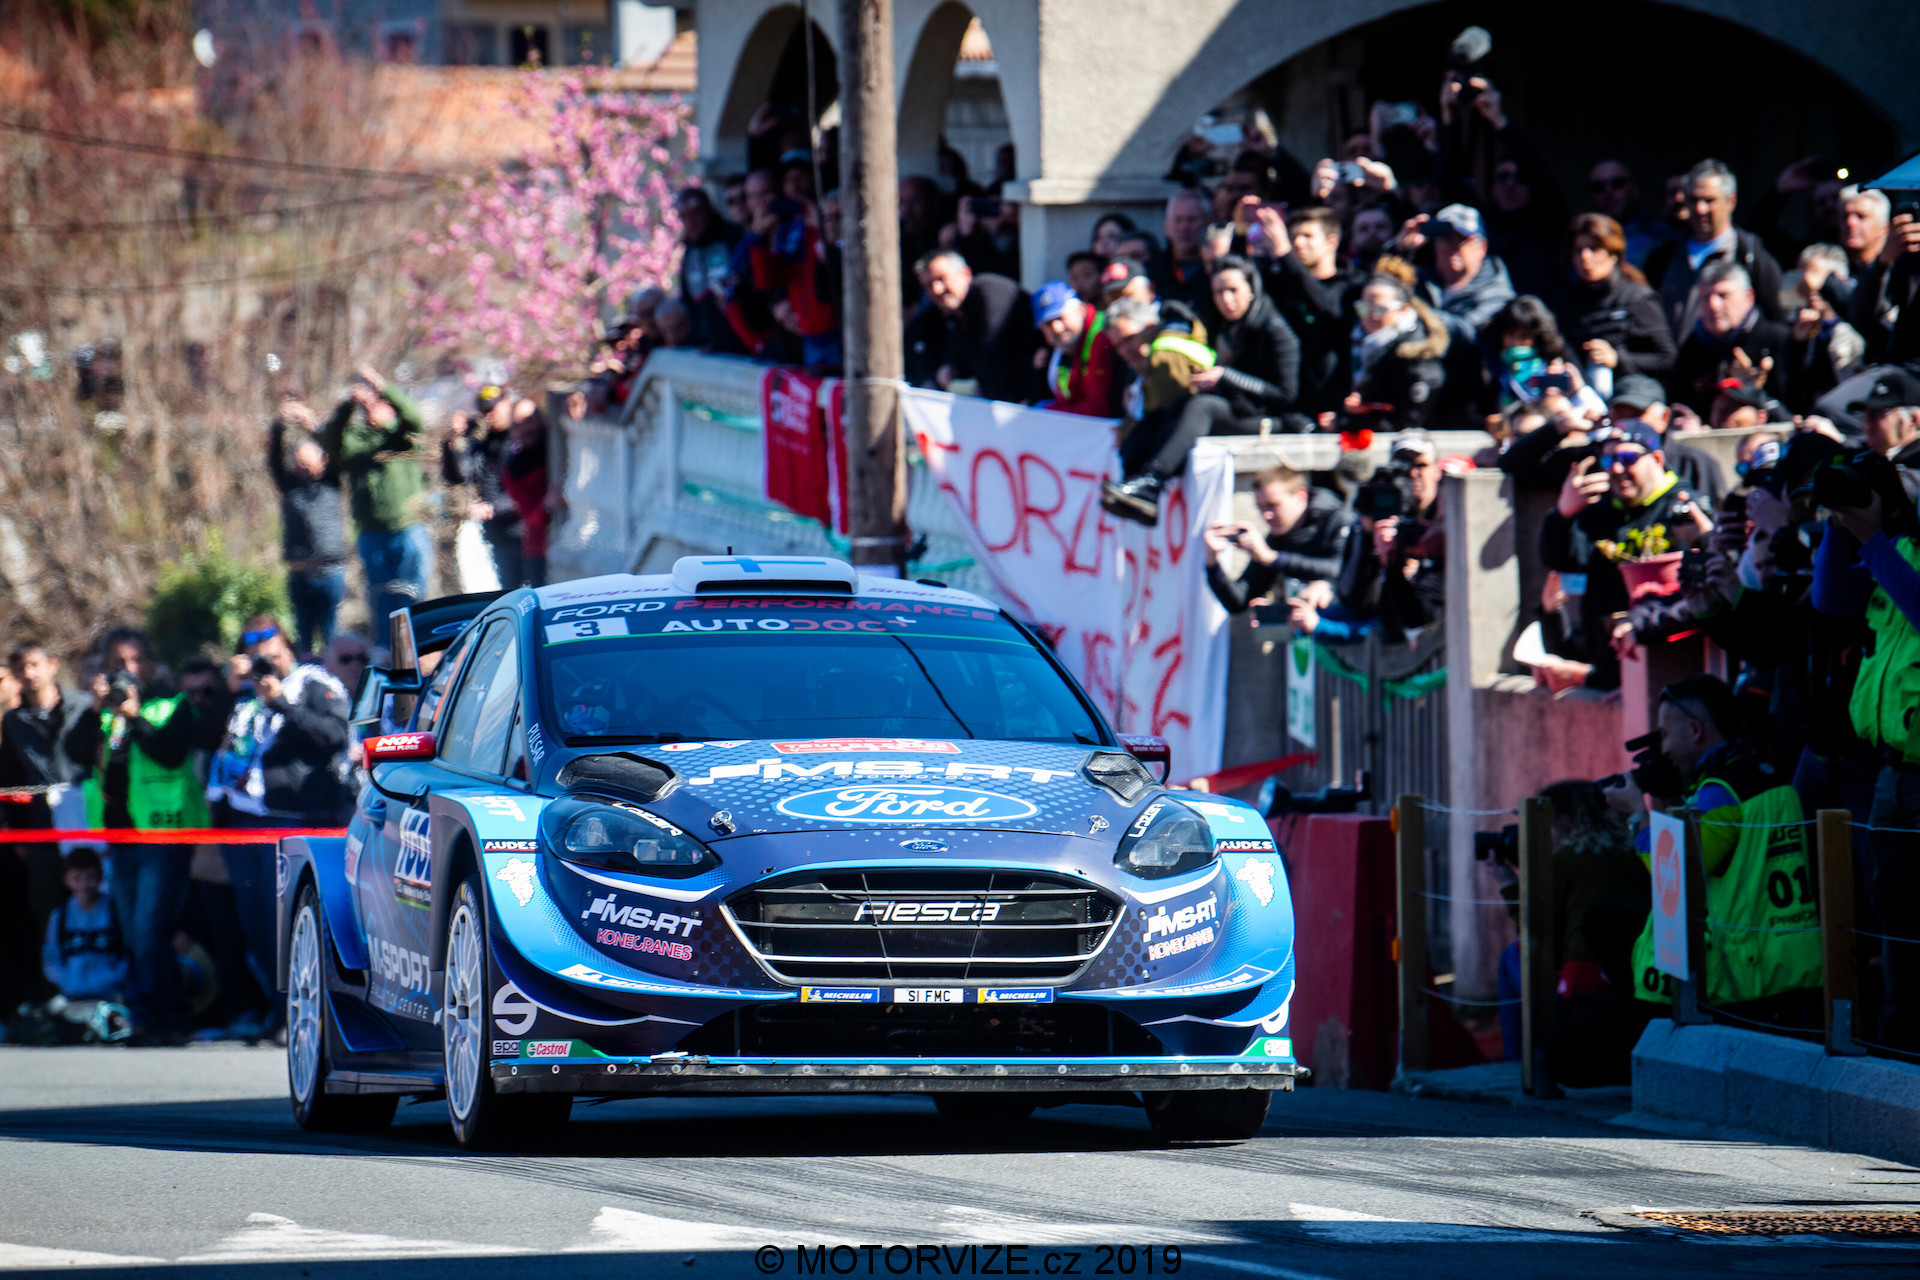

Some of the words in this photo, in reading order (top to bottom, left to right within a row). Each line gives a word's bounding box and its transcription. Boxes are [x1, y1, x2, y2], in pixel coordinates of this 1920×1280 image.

[551, 601, 667, 621] FORD
[672, 599, 996, 621] PERFORMANCE
[572, 620, 602, 637] 3
[526, 722, 546, 767] PULSAR
[762, 760, 1077, 784] MS-RT
[839, 774, 990, 782] TECHNOLOGY
[824, 787, 991, 818] Ford
[484, 840, 539, 851] AUDES
[1219, 840, 1274, 850] AUDES
[600, 901, 703, 937] MS-RT
[596, 927, 694, 961] KONECRANES
[367, 934, 431, 996] M-SPORT
[822, 992, 873, 1001] MICHELIN
[926, 989, 951, 1002] FMC
[999, 991, 1047, 1000] MICHELIN
[536, 1043, 568, 1055] Castrol
